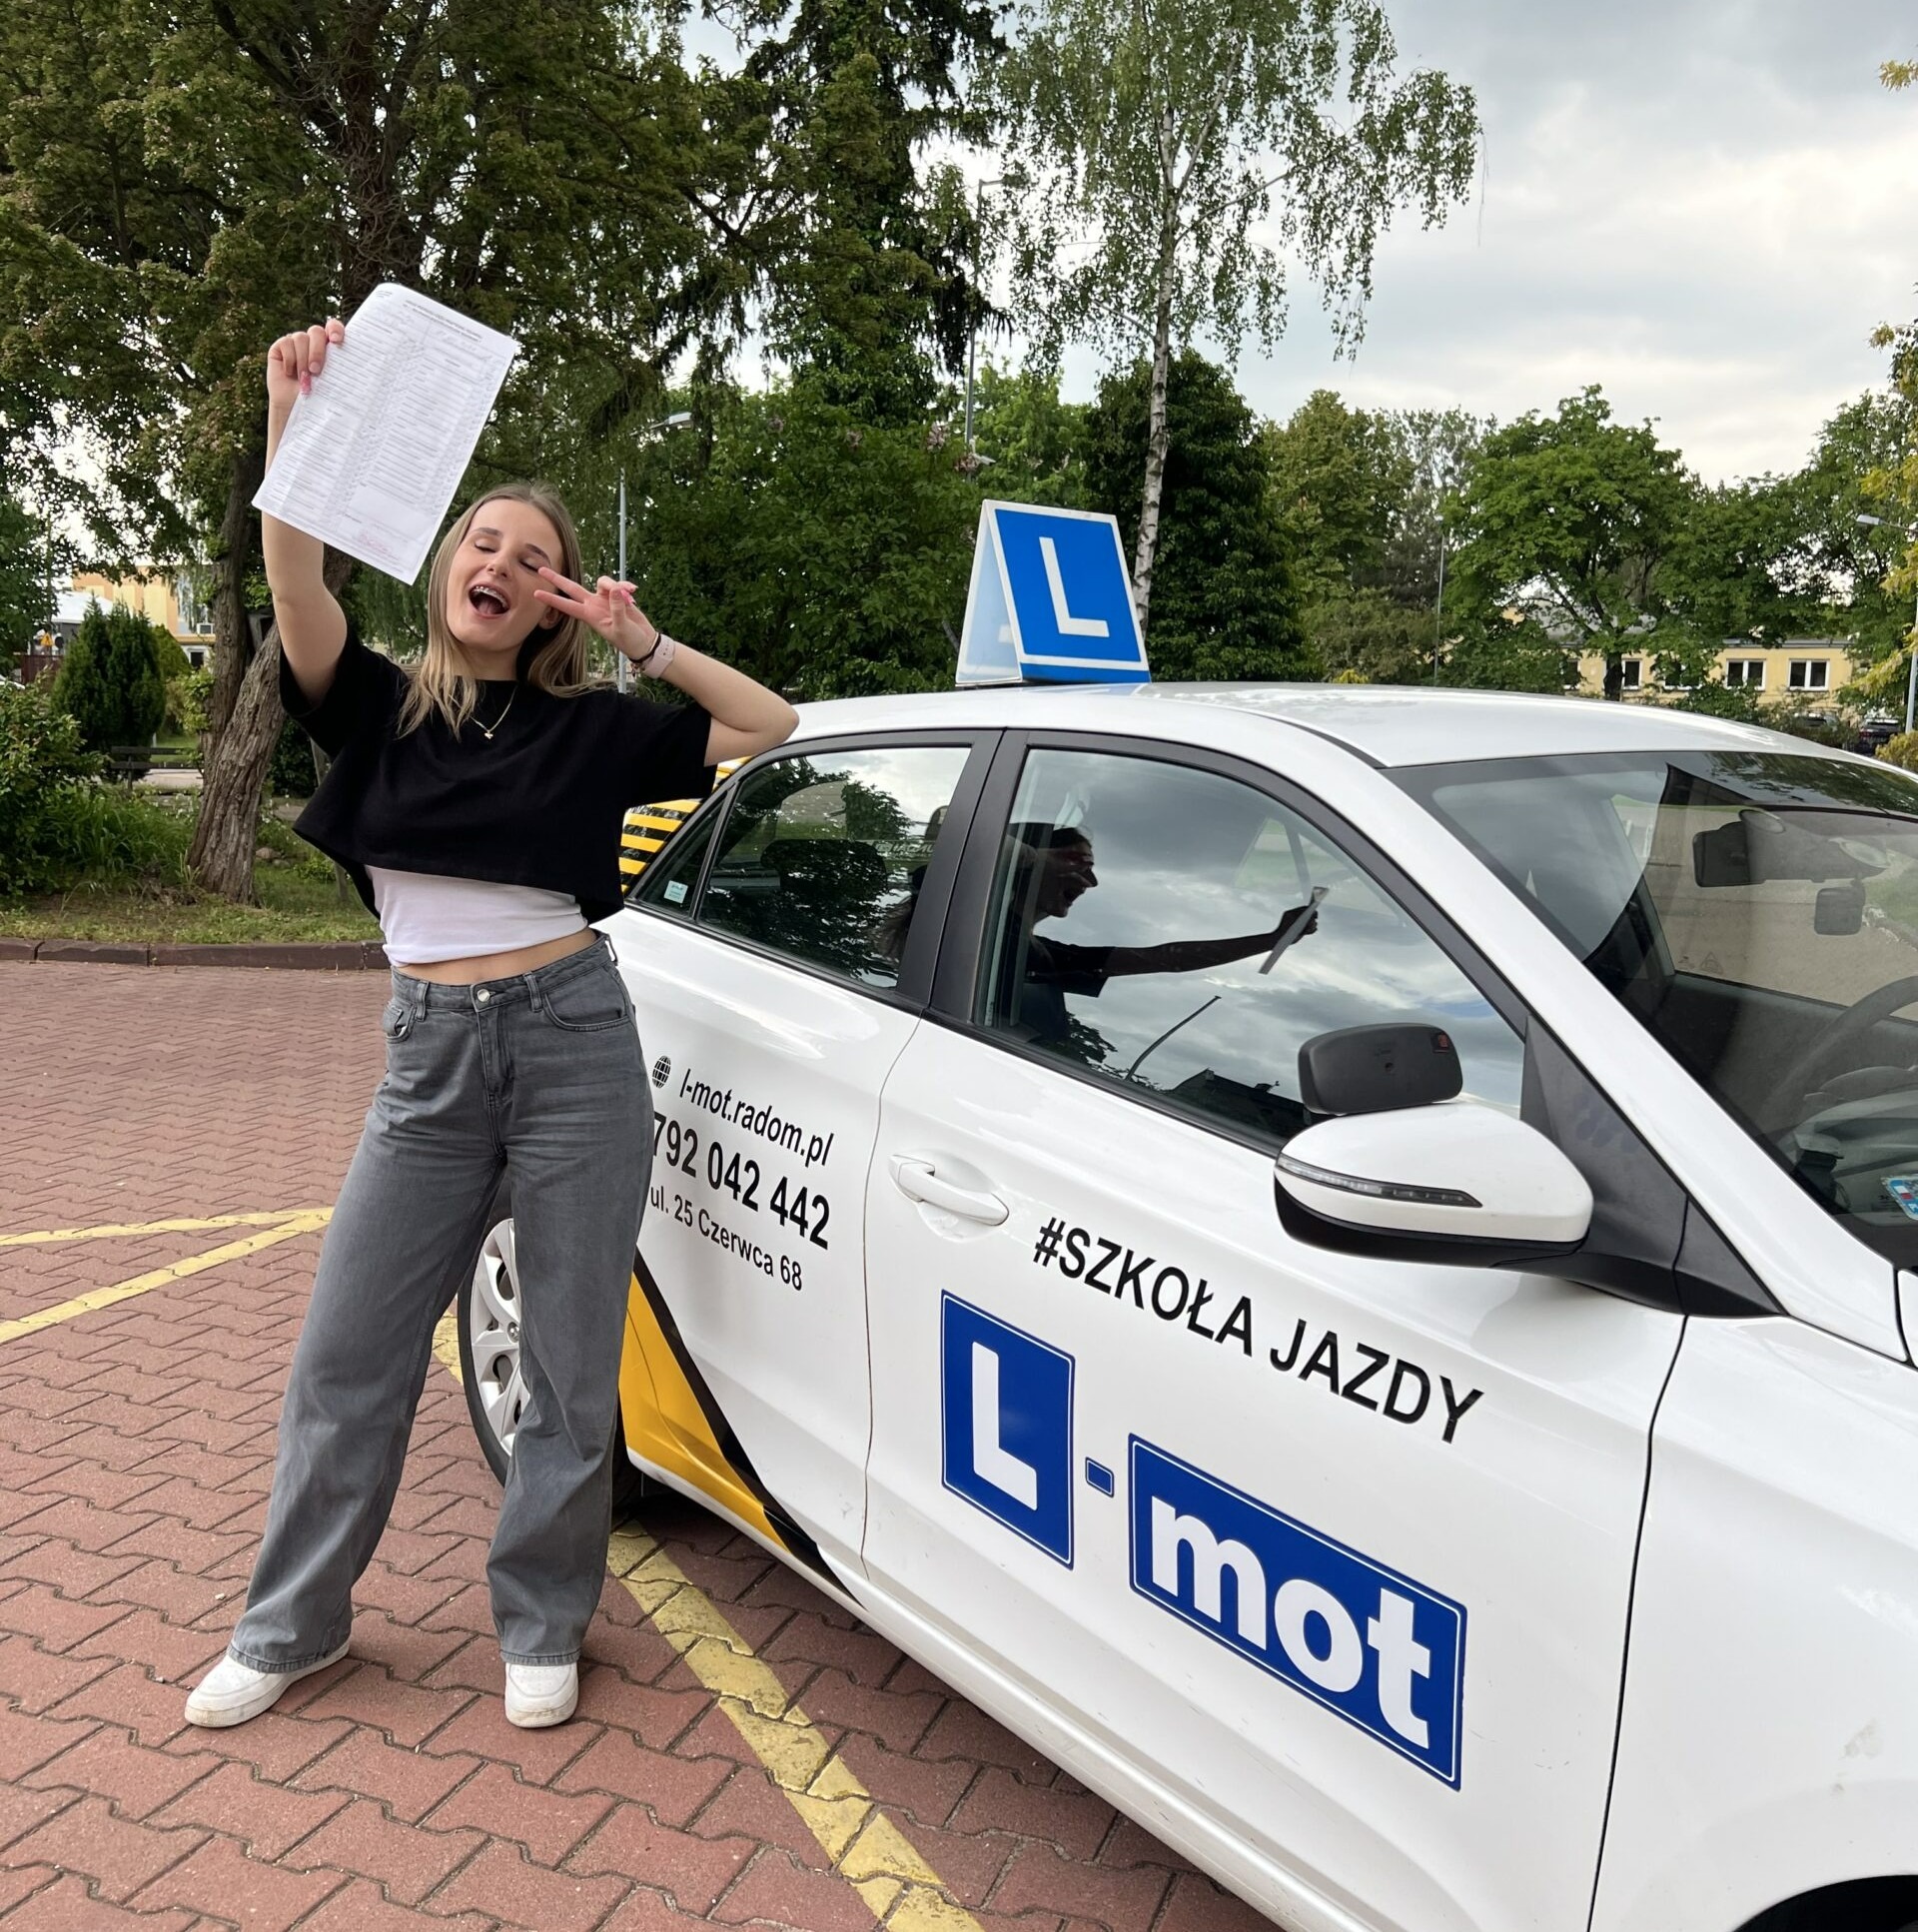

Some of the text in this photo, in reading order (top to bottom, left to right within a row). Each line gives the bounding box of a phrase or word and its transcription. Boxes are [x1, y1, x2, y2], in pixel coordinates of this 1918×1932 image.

[1039, 536, 1110, 638] L
[679, 1068, 834, 1168] l-mot.radom.pl
[653, 1111, 830, 1251] 792 042 442
[650, 1185, 802, 1292] ul. 25 Czerwca 68
[1033, 1217, 1484, 1445] #SZKOŁA JAZDY
